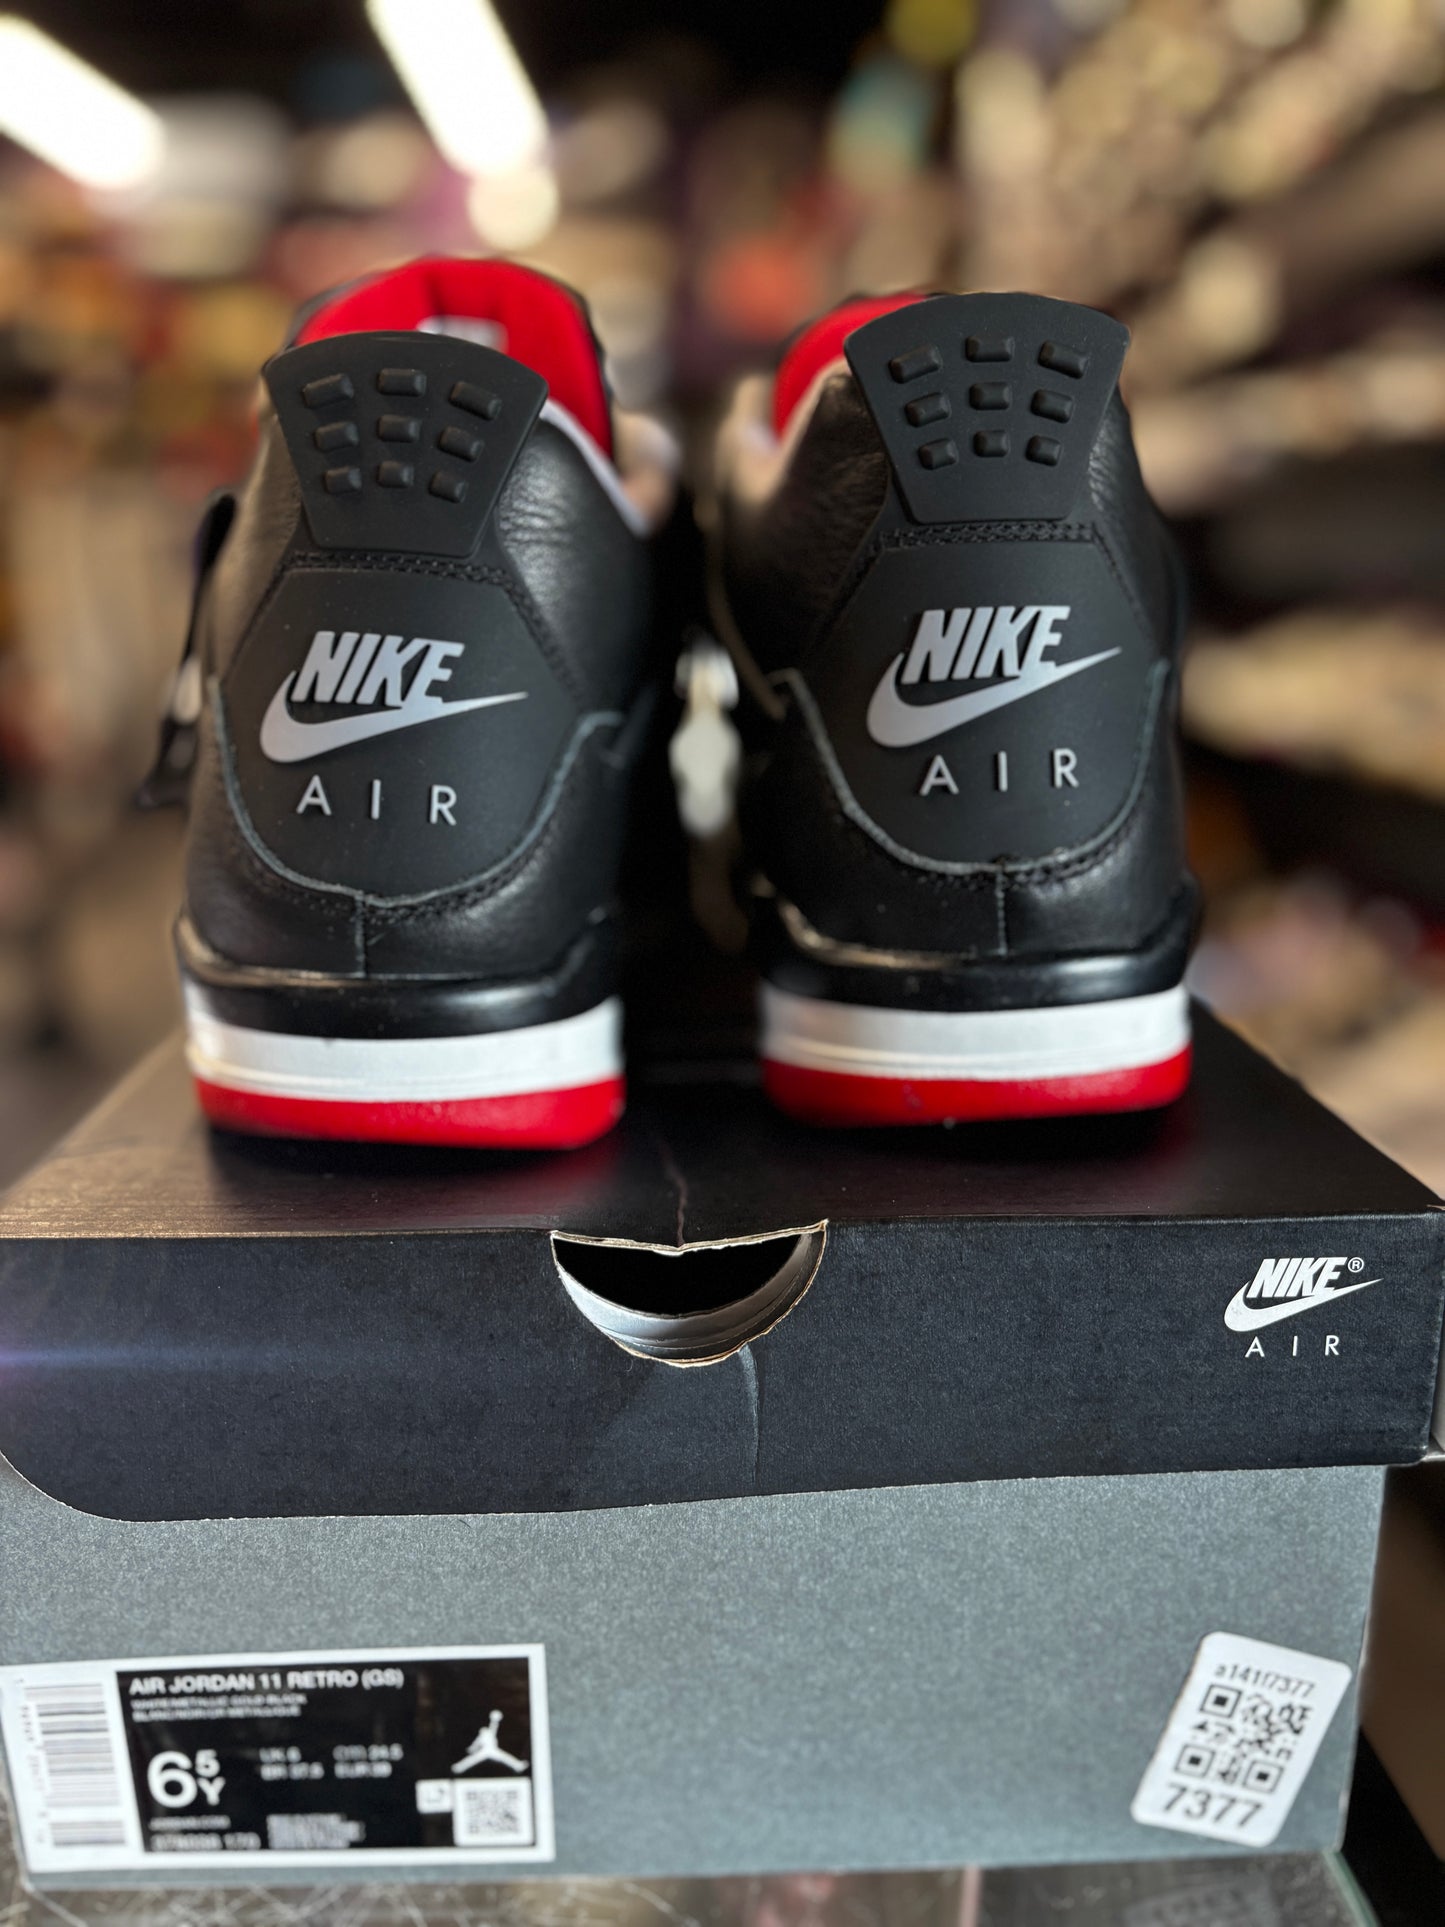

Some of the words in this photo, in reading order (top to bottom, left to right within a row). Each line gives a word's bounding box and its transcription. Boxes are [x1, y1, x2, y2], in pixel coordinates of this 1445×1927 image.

[902, 605, 1070, 684] NIKE
[291, 631, 465, 707] NIKE
[919, 748, 1079, 796] AIR
[296, 775, 457, 826] AIR
[1245, 1335, 1340, 1358] AIR
[129, 1676, 167, 1695] AIR
[169, 1673, 254, 1694] JORDAN
[259, 1672, 282, 1690] 11
[287, 1668, 358, 1690] RETRO
[1163, 1782, 1263, 1828] 7377
